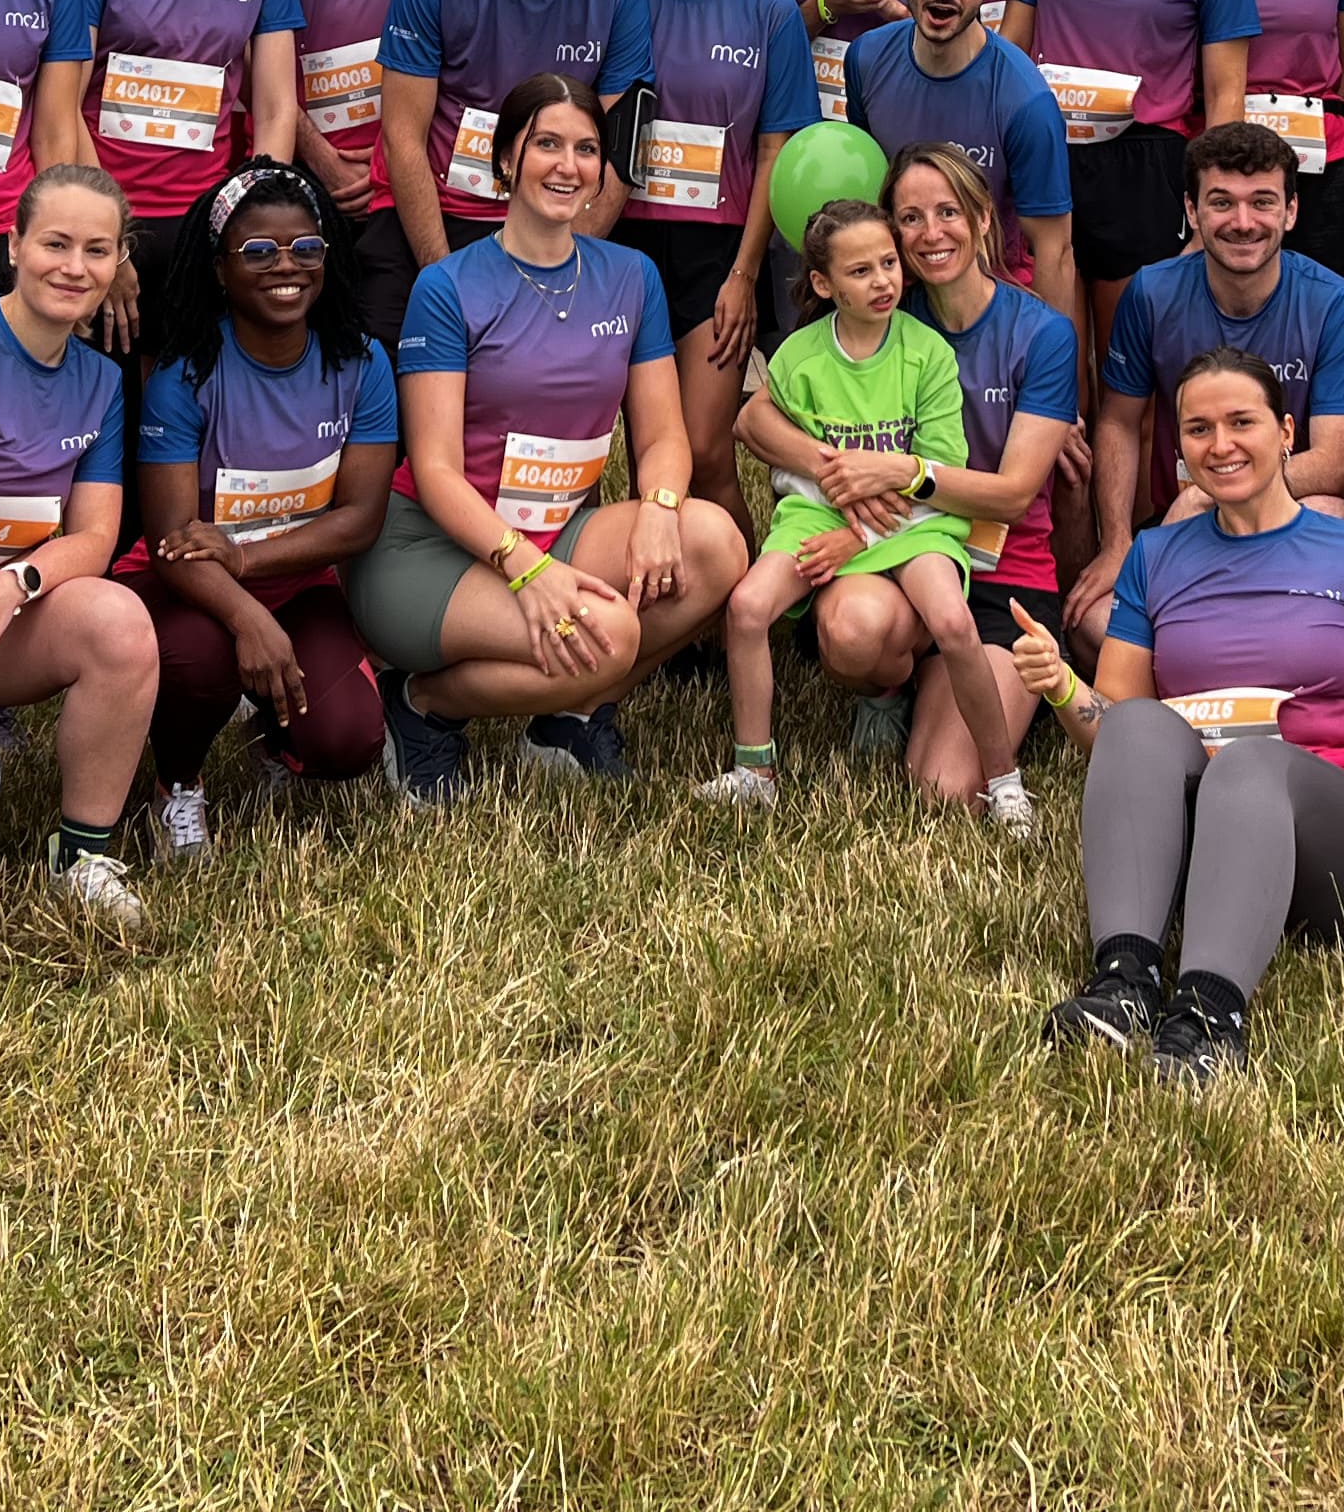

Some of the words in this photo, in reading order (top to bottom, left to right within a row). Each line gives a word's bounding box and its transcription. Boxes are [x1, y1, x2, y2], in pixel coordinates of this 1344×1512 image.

[5, 11, 45, 29] mc2i
[556, 41, 601, 62] mc2i
[711, 45, 759, 68] mc2i
[312, 67, 371, 94] 404008
[115, 81, 185, 104] 404017
[652, 145, 683, 164] 039
[591, 315, 628, 337] mc2i
[515, 464, 584, 487] 404037
[229, 493, 306, 517] 404003
